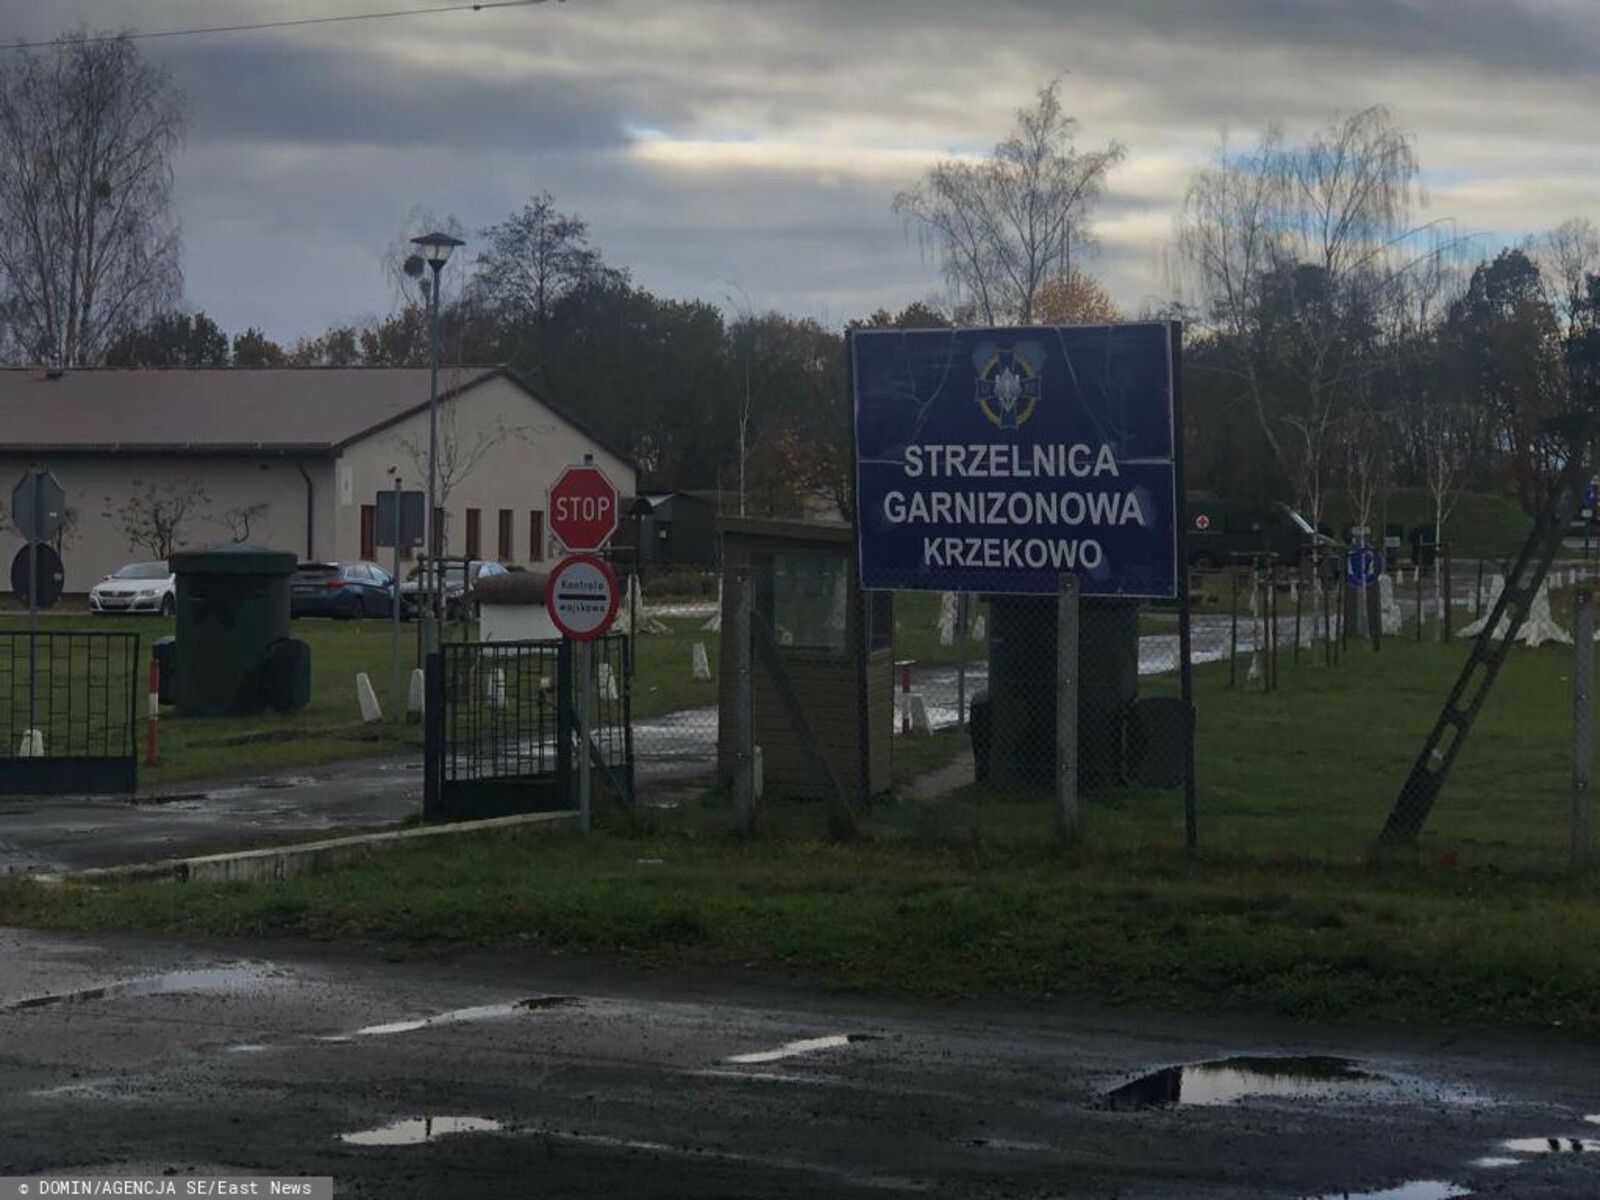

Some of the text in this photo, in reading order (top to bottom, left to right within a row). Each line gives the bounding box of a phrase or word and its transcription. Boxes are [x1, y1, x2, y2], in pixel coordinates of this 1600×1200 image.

[904, 444, 1119, 477] STRZELNICA
[556, 497, 610, 522] STOP
[883, 491, 1146, 526] GARNIZONOWA
[923, 537, 1102, 569] KRZEKOWO
